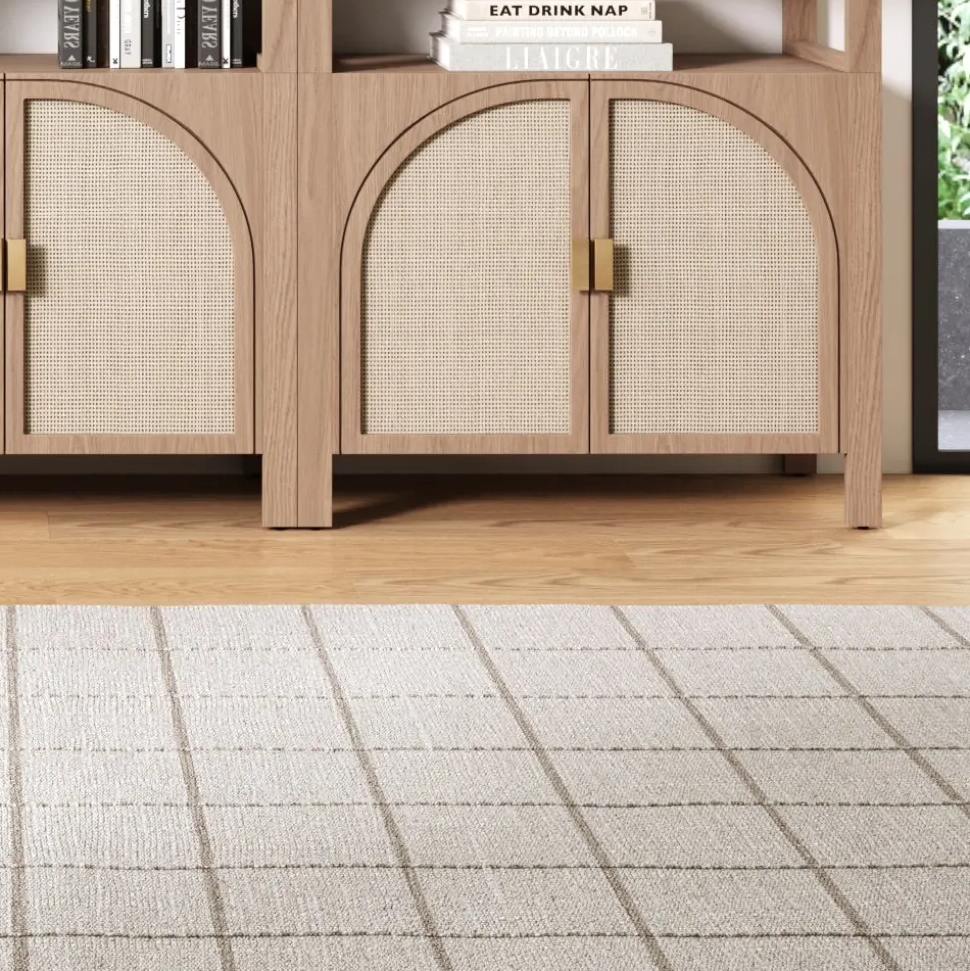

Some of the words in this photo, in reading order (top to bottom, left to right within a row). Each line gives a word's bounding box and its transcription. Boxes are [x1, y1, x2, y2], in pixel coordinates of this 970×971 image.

[489, 5, 523, 16] EAT
[529, 5, 585, 16] DRINK
[591, 5, 628, 16] NAP
[496, 27, 544, 37] PAINTING
[592, 27, 638, 37] POLLOCK
[505, 46, 618, 70] LIAIGRE
